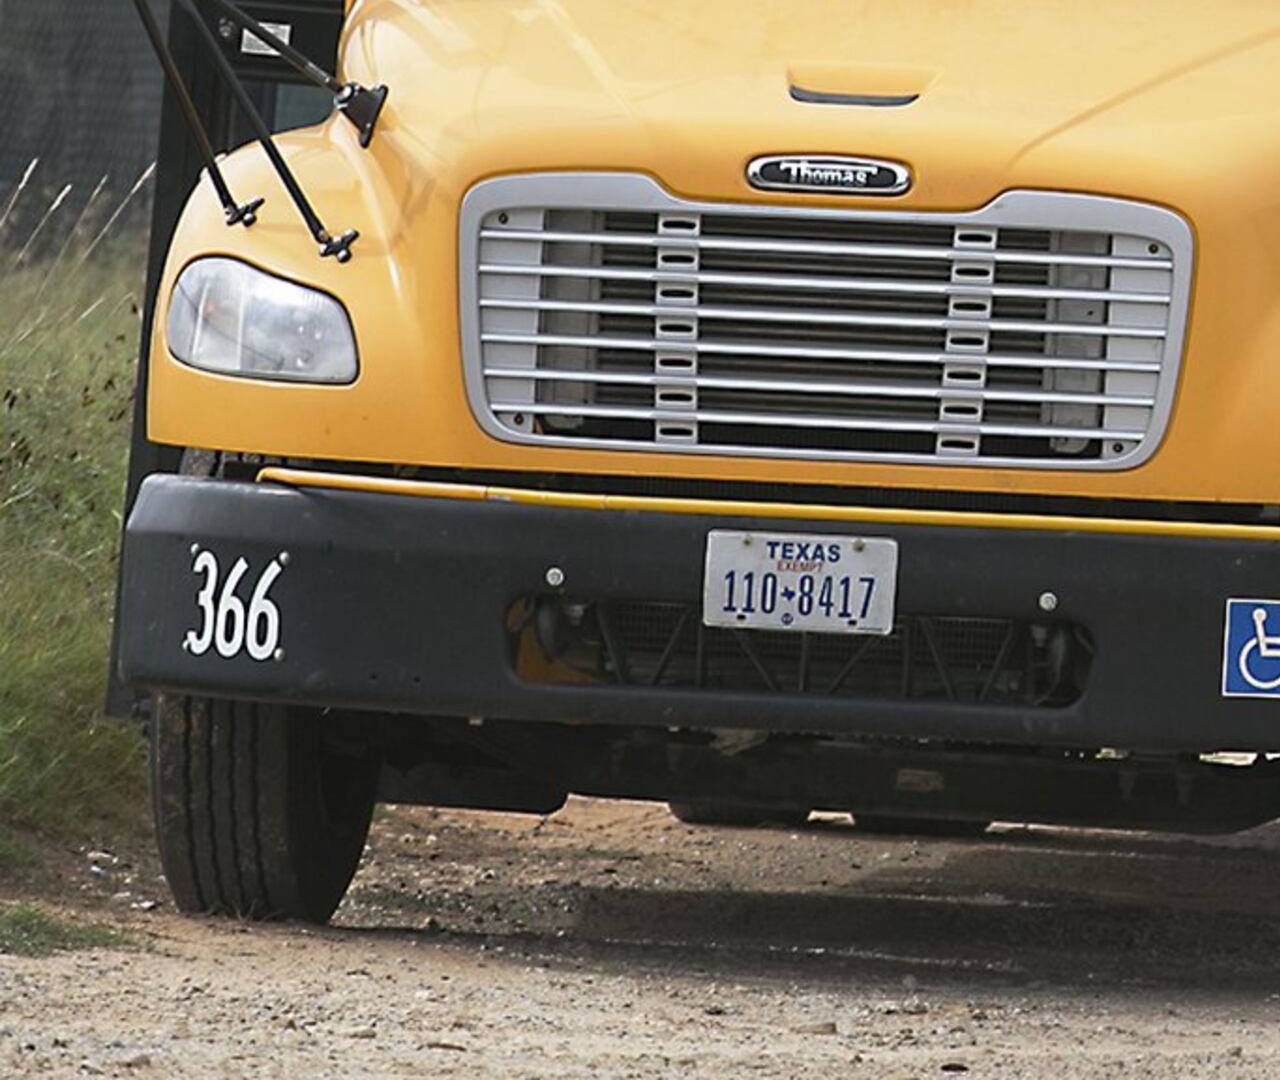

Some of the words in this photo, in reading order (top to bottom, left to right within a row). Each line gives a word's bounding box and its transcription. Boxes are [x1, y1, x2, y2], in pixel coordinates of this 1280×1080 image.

[779, 161, 879, 188] Thomas
[766, 541, 842, 563] TEXAS
[776, 561, 824, 573] EXEMPT
[186, 550, 283, 661] 366
